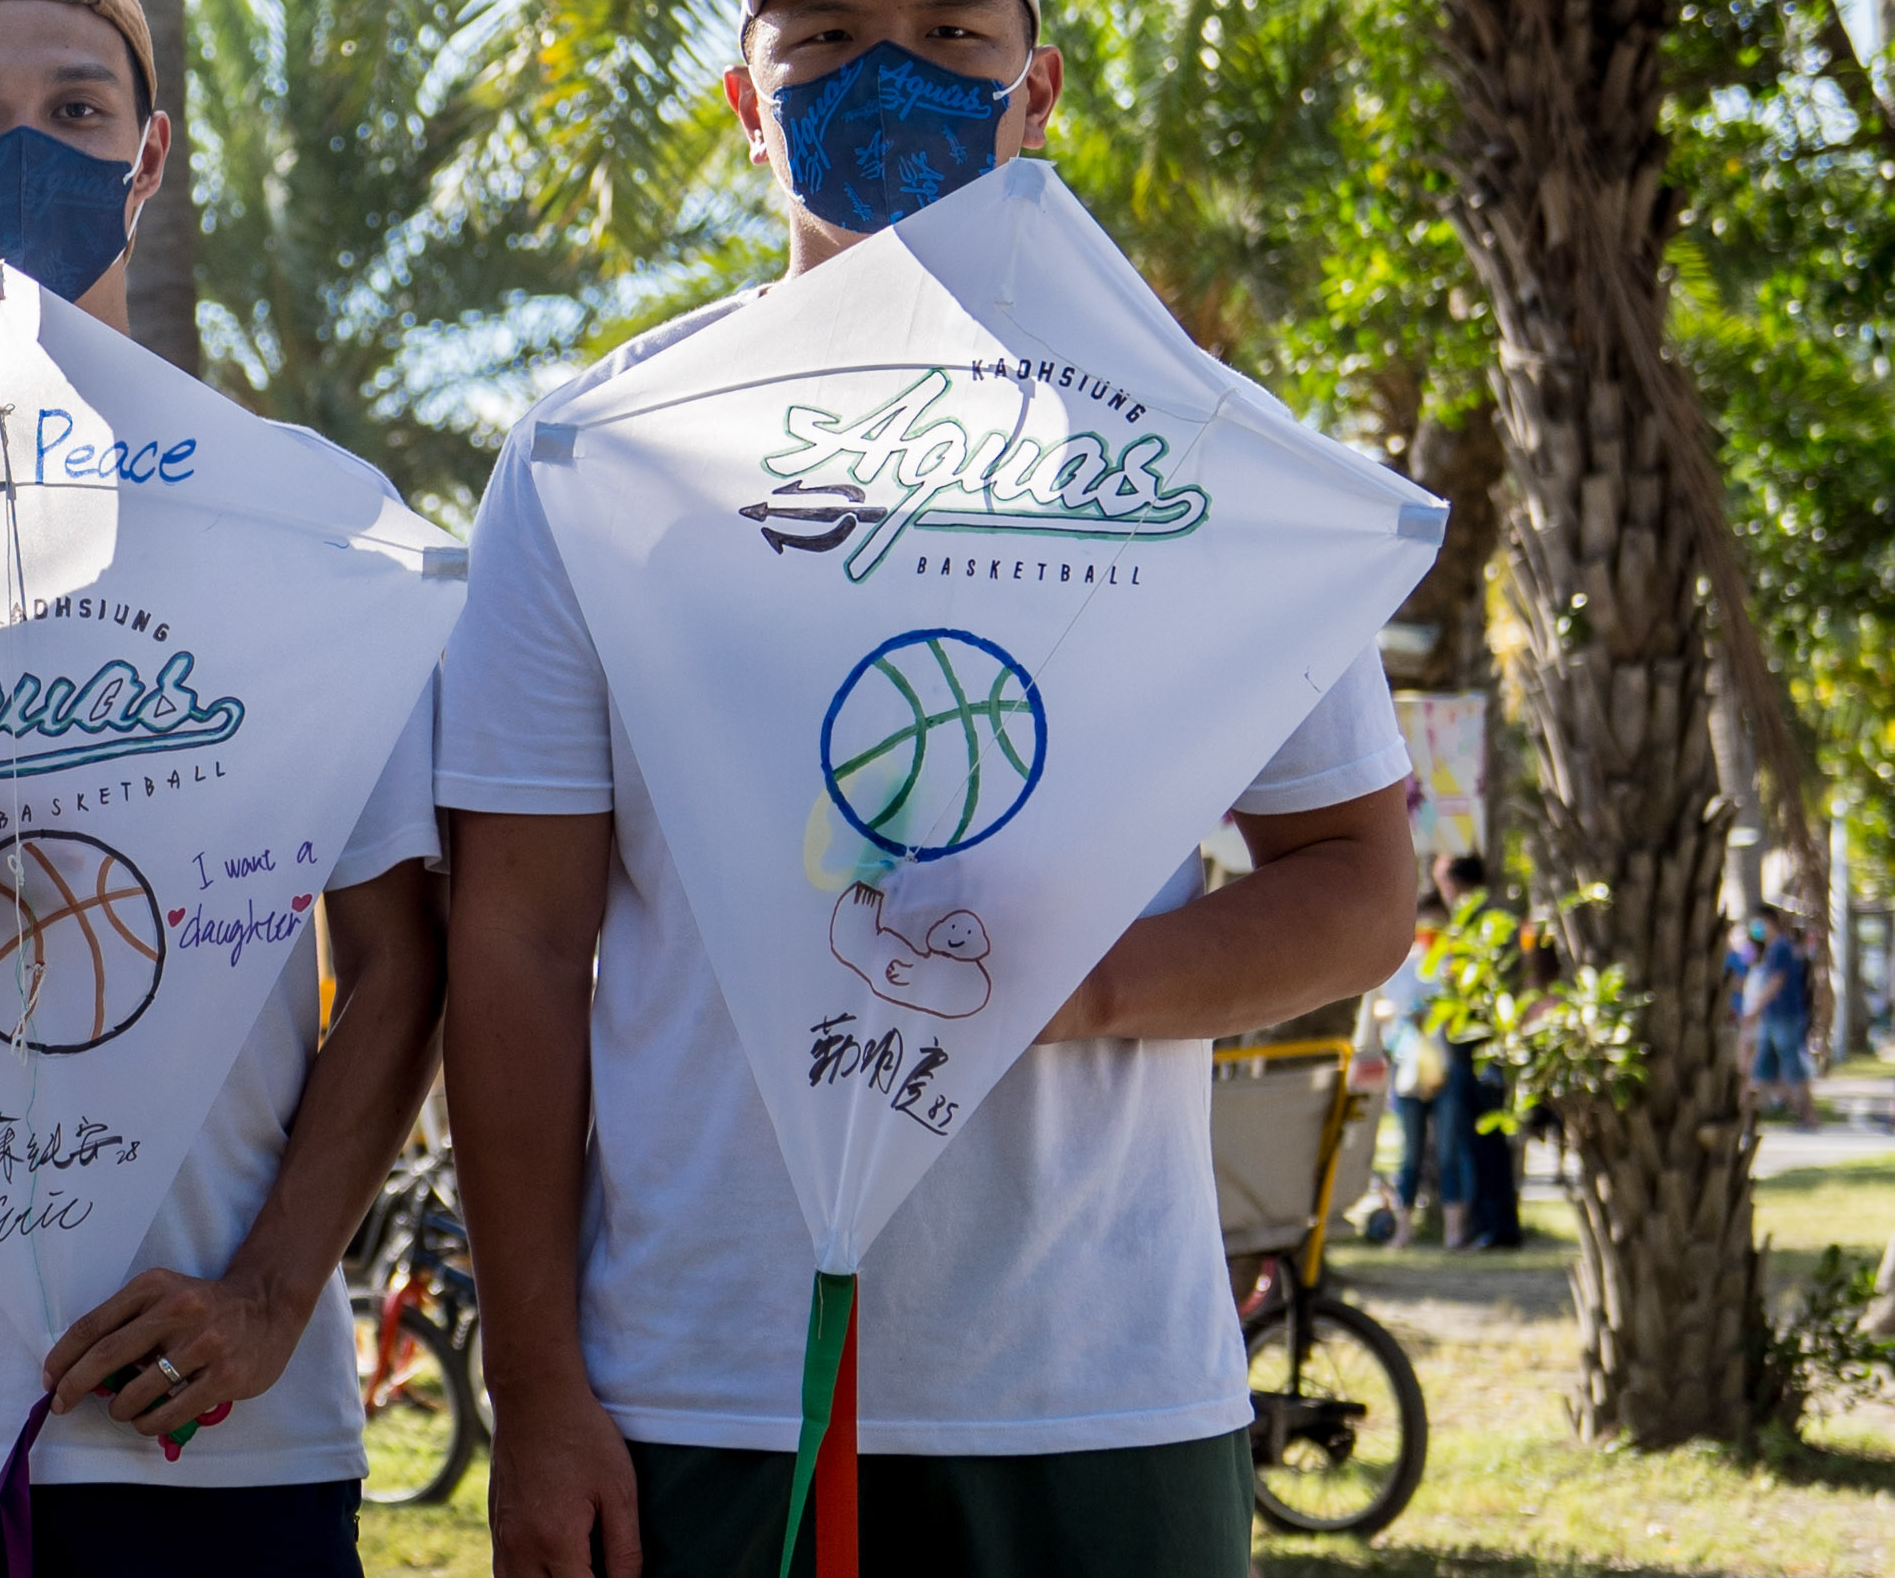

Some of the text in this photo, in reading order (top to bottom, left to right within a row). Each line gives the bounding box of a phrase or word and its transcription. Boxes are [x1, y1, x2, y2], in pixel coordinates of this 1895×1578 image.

[878, 60, 993, 122] Aquas
[970, 357, 1147, 424] KAOHSIUNG
[35, 408, 197, 485] Peace
[759, 366, 1213, 585] Aquas
[916, 555, 1142, 586] BASKETBALL
[192, 841, 317, 890] I want a
[179, 898, 301, 967] daughter
[928, 1094, 959, 1128] 85
[116, 1140, 141, 1166] 28
